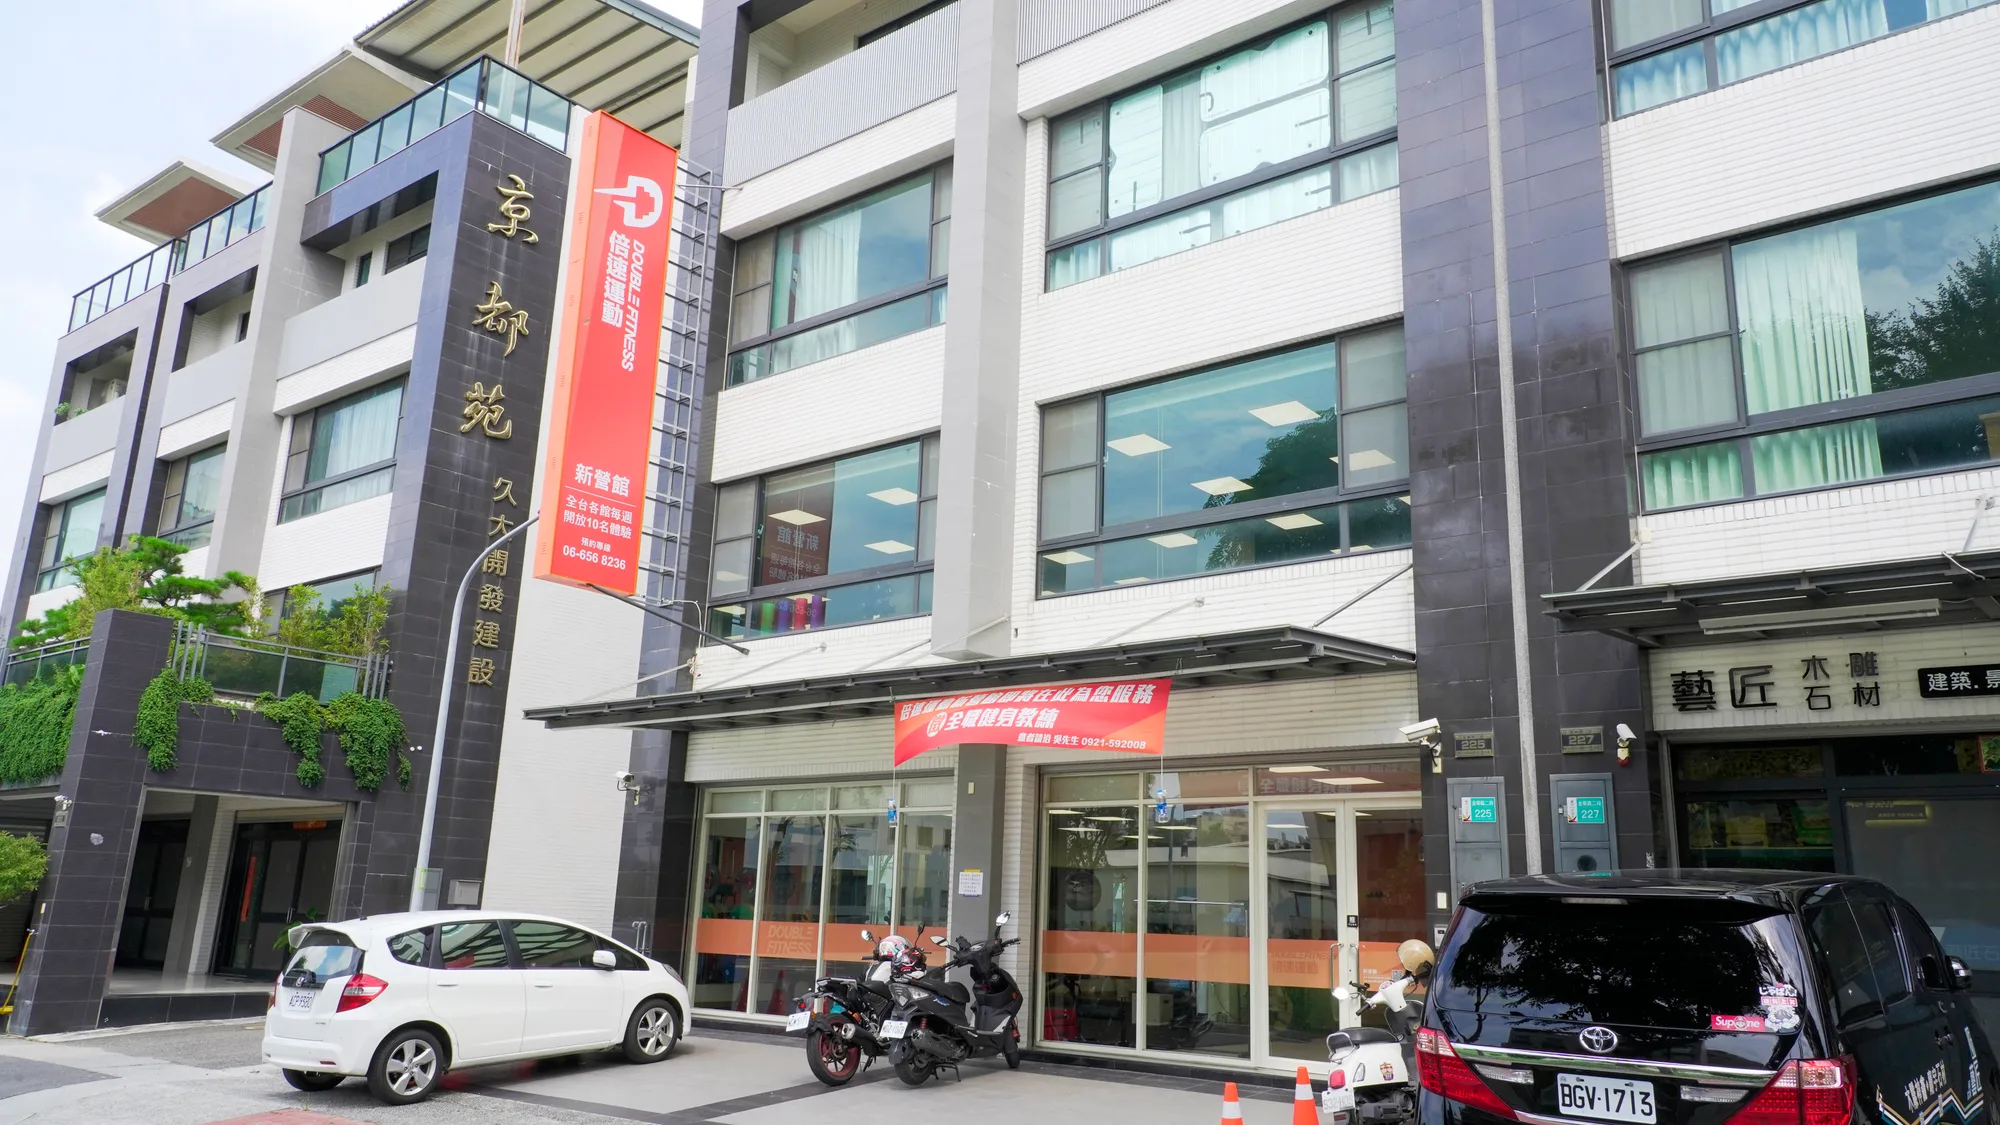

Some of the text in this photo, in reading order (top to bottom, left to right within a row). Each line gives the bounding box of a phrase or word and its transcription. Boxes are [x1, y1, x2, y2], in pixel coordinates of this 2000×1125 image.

[601, 230, 630, 328] 倍速運動
[621, 239, 645, 372] DOUBLE FITNESS
[574, 463, 630, 497] 新營館
[565, 494, 633, 525] 全台各館每週
[563, 510, 632, 539] 開放10名體驗
[562, 545, 627, 570] 06-656 8236
[468, 476, 518, 687] 久大開發建設
[1801, 652, 1880, 680] 木雕
[1670, 665, 1777, 712] 藝匠
[1803, 682, 1881, 710] 石材
[944, 708, 1060, 731] 全職健身教練
[1053, 735, 1079, 745] 吳先生
[1081, 737, 1146, 749] 0921-592008
[1461, 740, 1486, 749] 225
[1568, 735, 1594, 745] 227
[1475, 809, 1492, 818] 225
[1581, 810, 1599, 819] 227
[768, 925, 814, 940] DOUBLE
[767, 940, 812, 954] FITNESS
